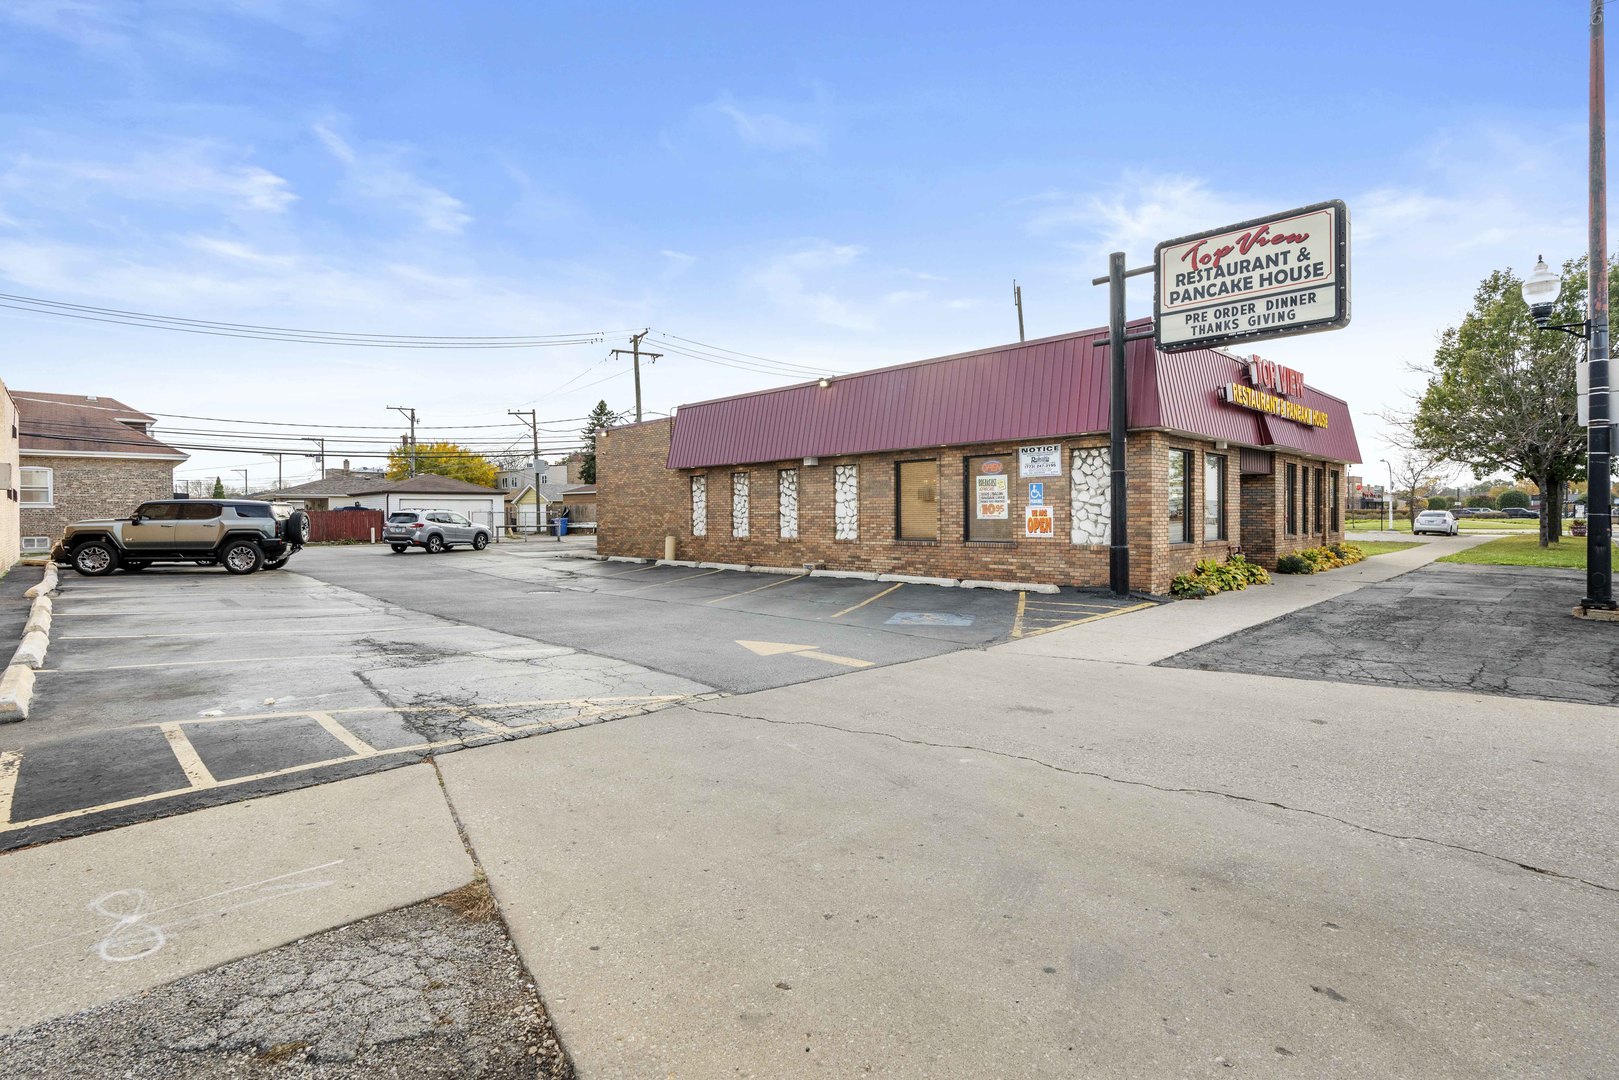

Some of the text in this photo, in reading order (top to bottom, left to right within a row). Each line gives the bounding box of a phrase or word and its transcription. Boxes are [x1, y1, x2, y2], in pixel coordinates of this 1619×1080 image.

[1175, 247, 1311, 288] RESTAURANT &
[1181, 224, 1309, 271] Top View
[1169, 261, 1324, 305] PANCAKE HOUSE
[1185, 292, 1317, 325] PRE ORDER DINNER
[1191, 319, 1239, 336] THANKS
[1247, 309, 1296, 327] GIVING
[1251, 354, 1304, 398] TOP VIEW
[1232, 382, 1279, 415] RESTAURANT
[1312, 409, 1328, 429] HOUSE
[1027, 518, 1052, 533] OPEN
